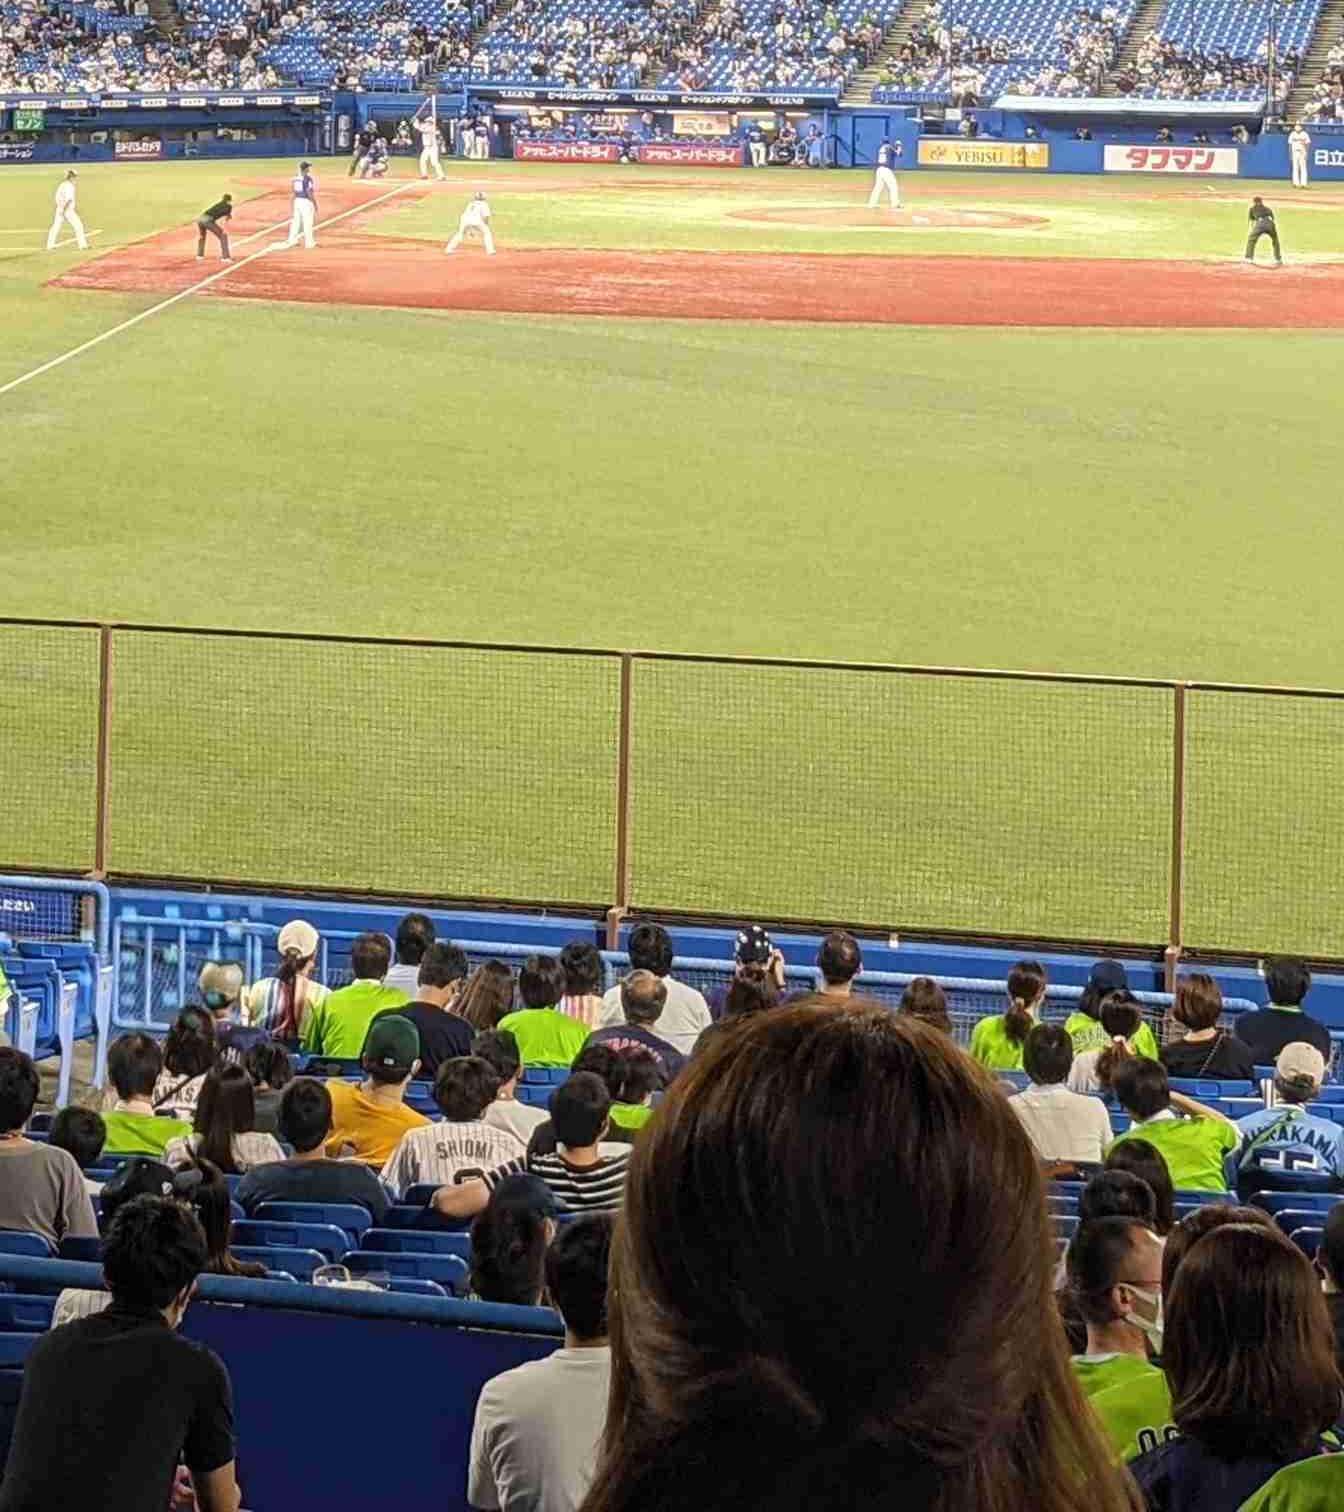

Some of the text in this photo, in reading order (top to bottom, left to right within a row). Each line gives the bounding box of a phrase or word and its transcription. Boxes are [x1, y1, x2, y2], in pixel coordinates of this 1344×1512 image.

[955, 150, 1004, 164] YEBISU
[1125, 148, 1215, 170] タフマン
[436, 1139, 494, 1161] SHIOMI
